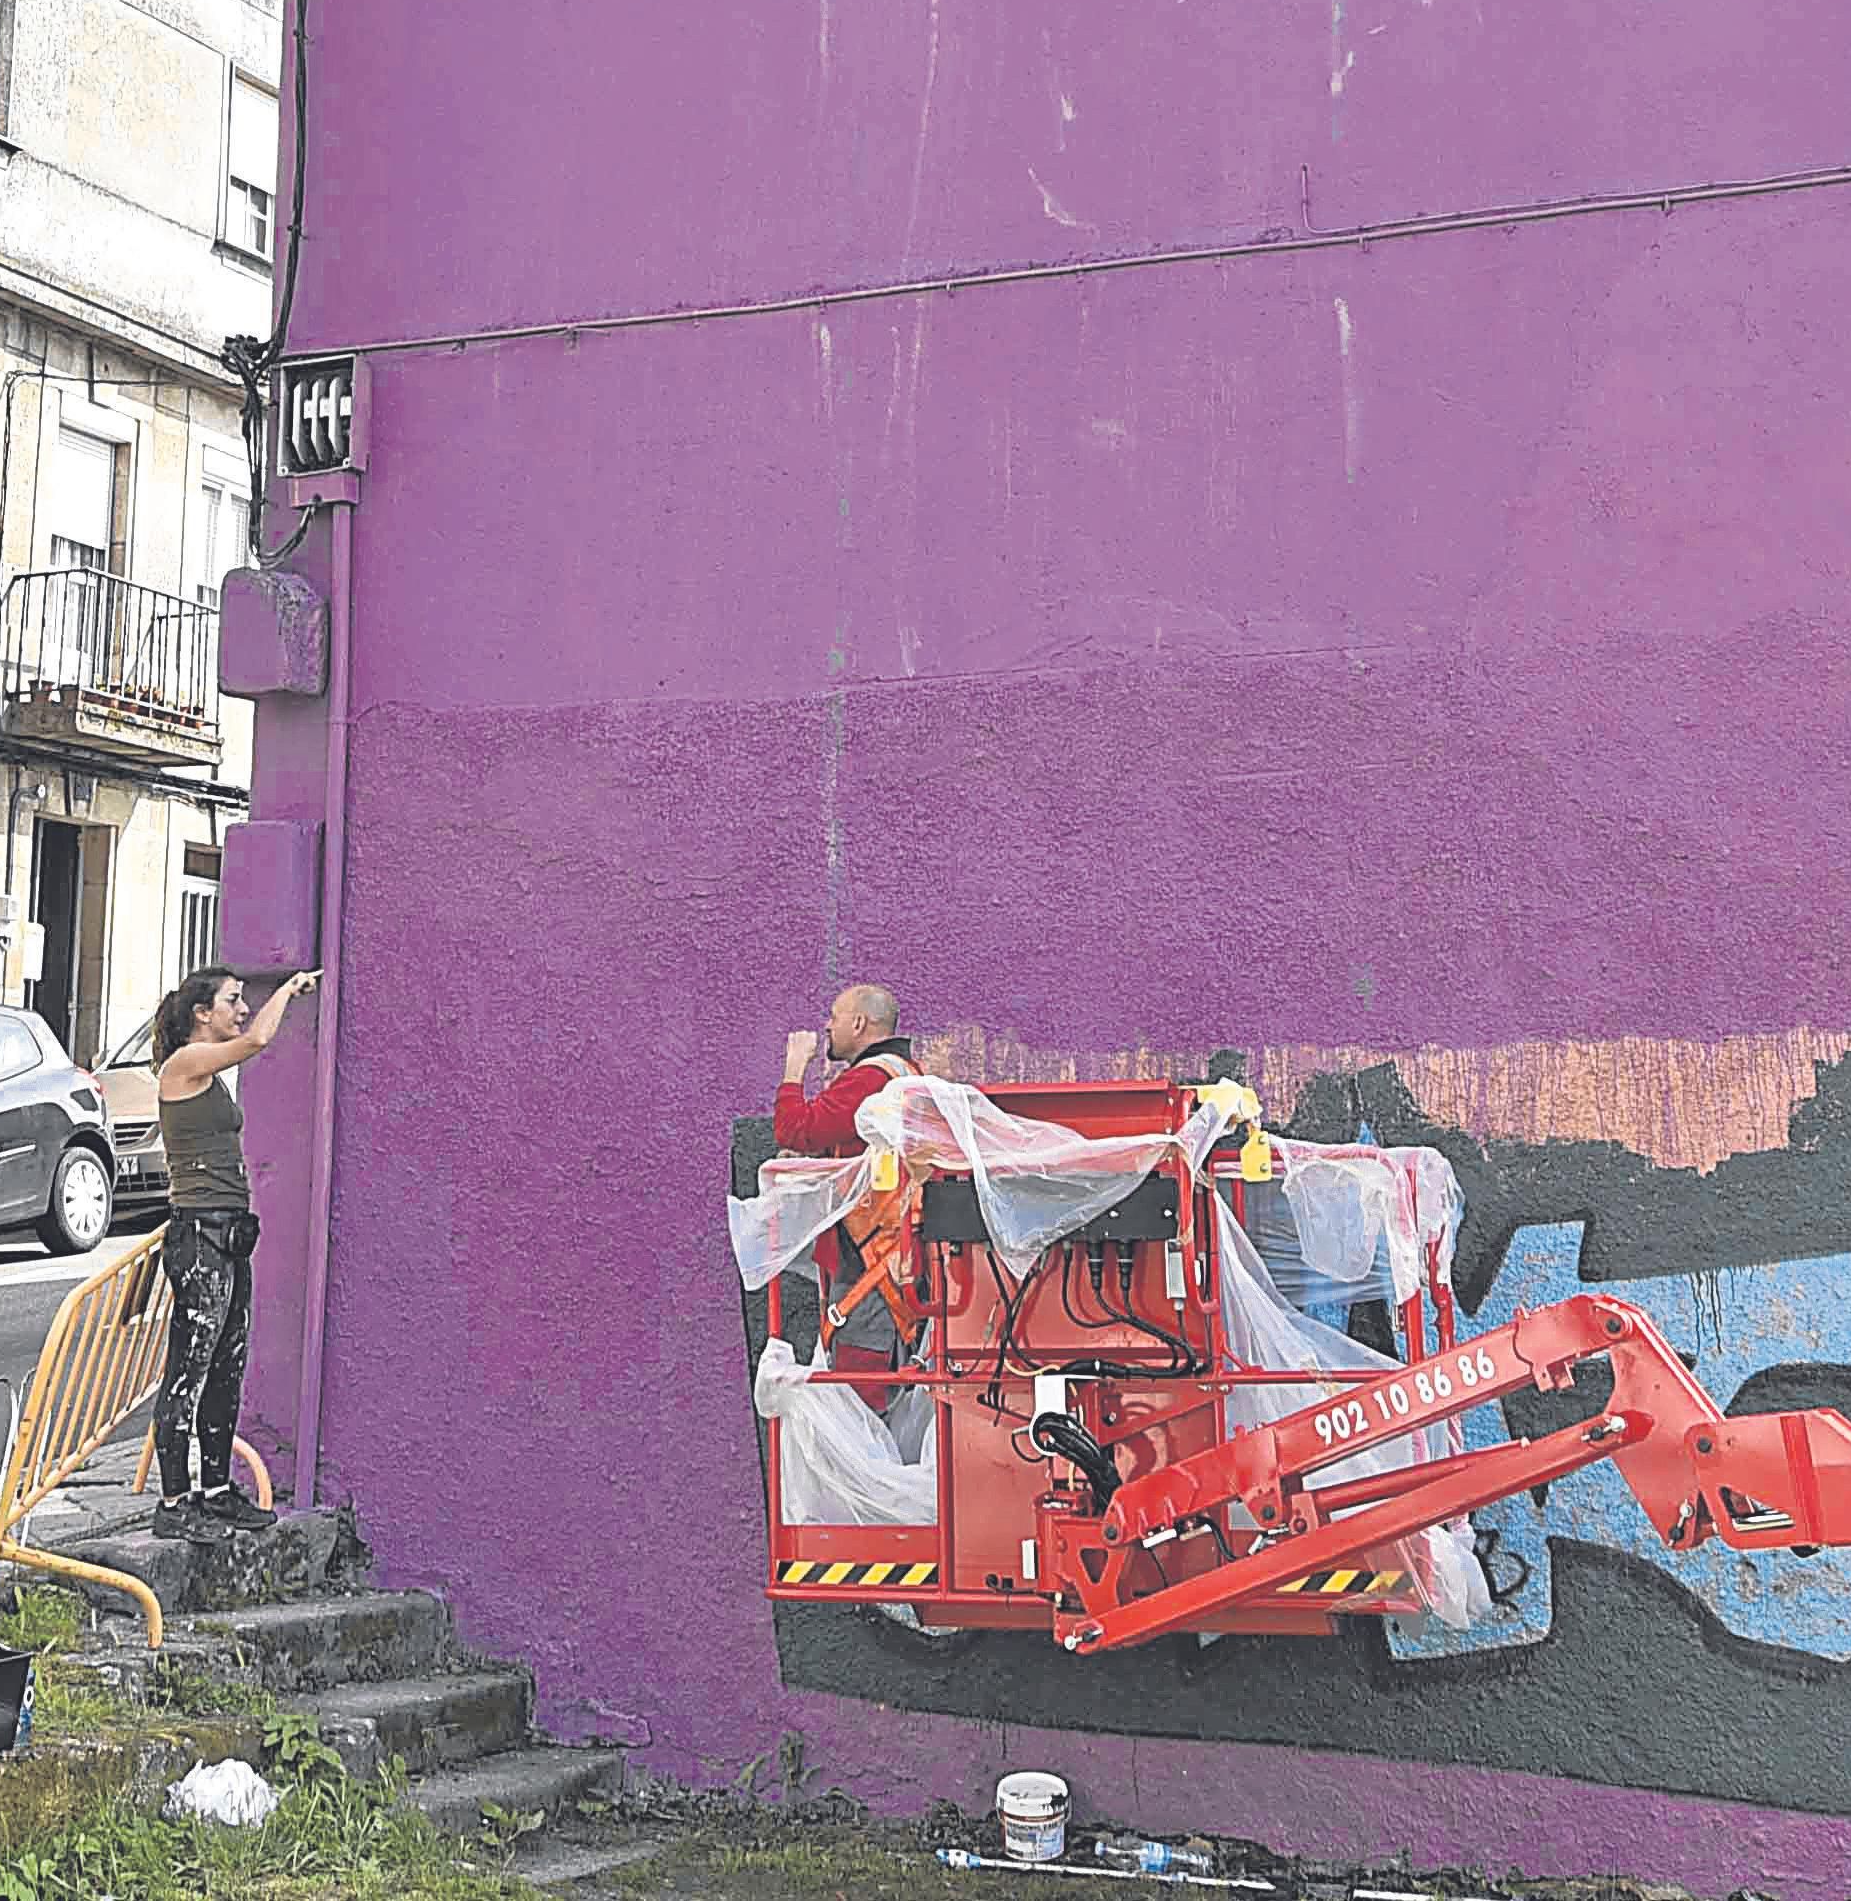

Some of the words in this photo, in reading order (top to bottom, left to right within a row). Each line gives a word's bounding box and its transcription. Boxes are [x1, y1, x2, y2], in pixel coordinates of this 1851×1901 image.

[1314, 1400, 1369, 1446] 902
[1373, 1383, 1410, 1420] 10
[1414, 1365, 1452, 1404] 86
[1457, 1347, 1495, 1387] 86
